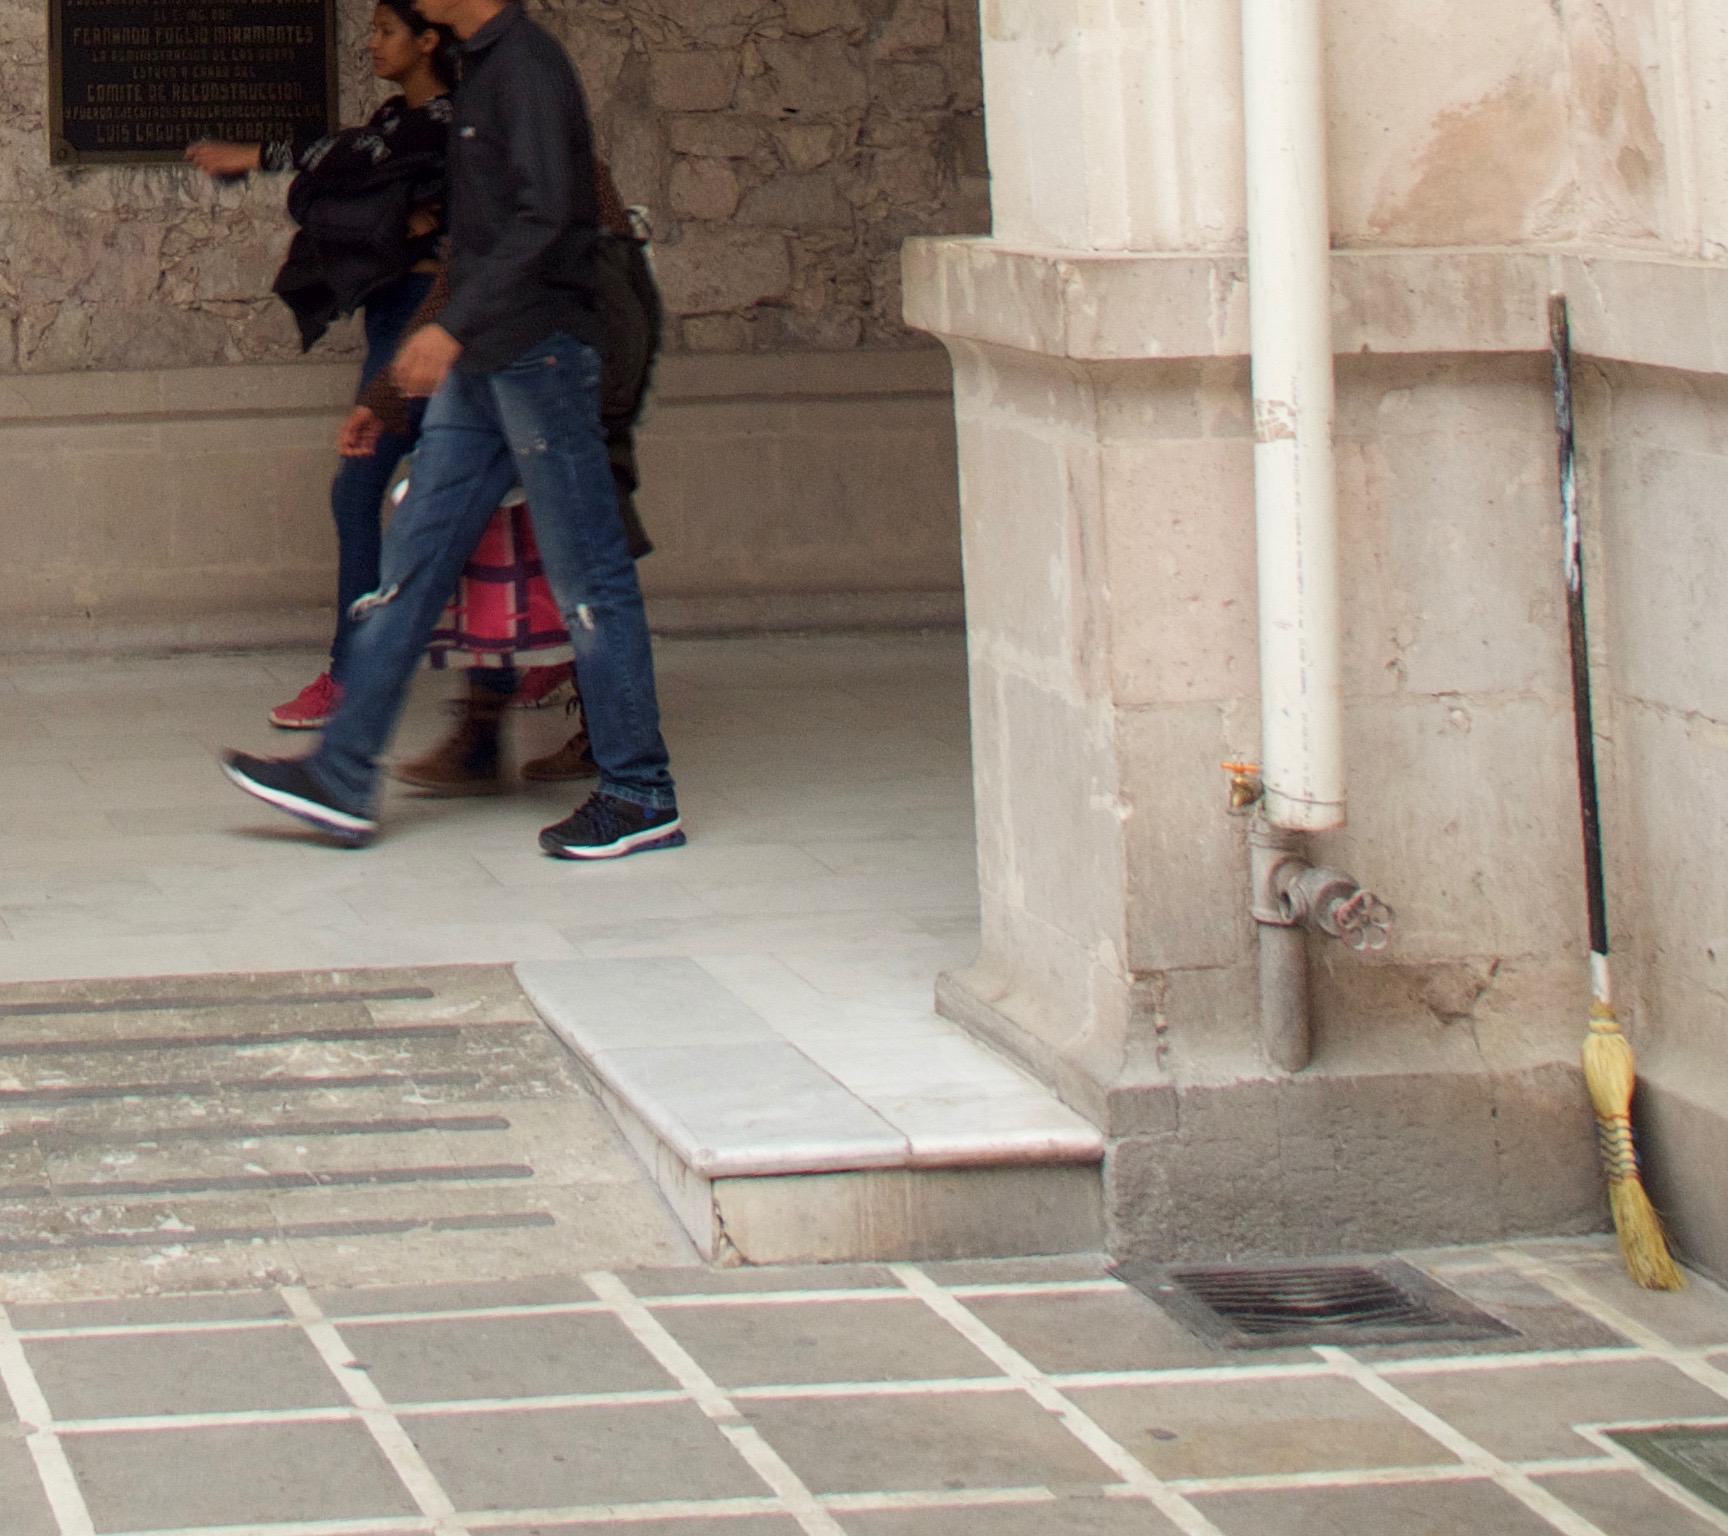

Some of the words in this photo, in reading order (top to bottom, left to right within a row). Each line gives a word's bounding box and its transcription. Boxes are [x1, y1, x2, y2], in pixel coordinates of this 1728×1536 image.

[73, 26, 150, 46] FERNANDO
[154, 26, 209, 46] FOGLIO
[213, 24, 314, 44] MIRAMONTES
[87, 83, 143, 102] COMITE
[149, 83, 166, 102] DE
[172, 81, 302, 101] RECONSTRUCCION
[96, 123, 130, 143] LUIS
